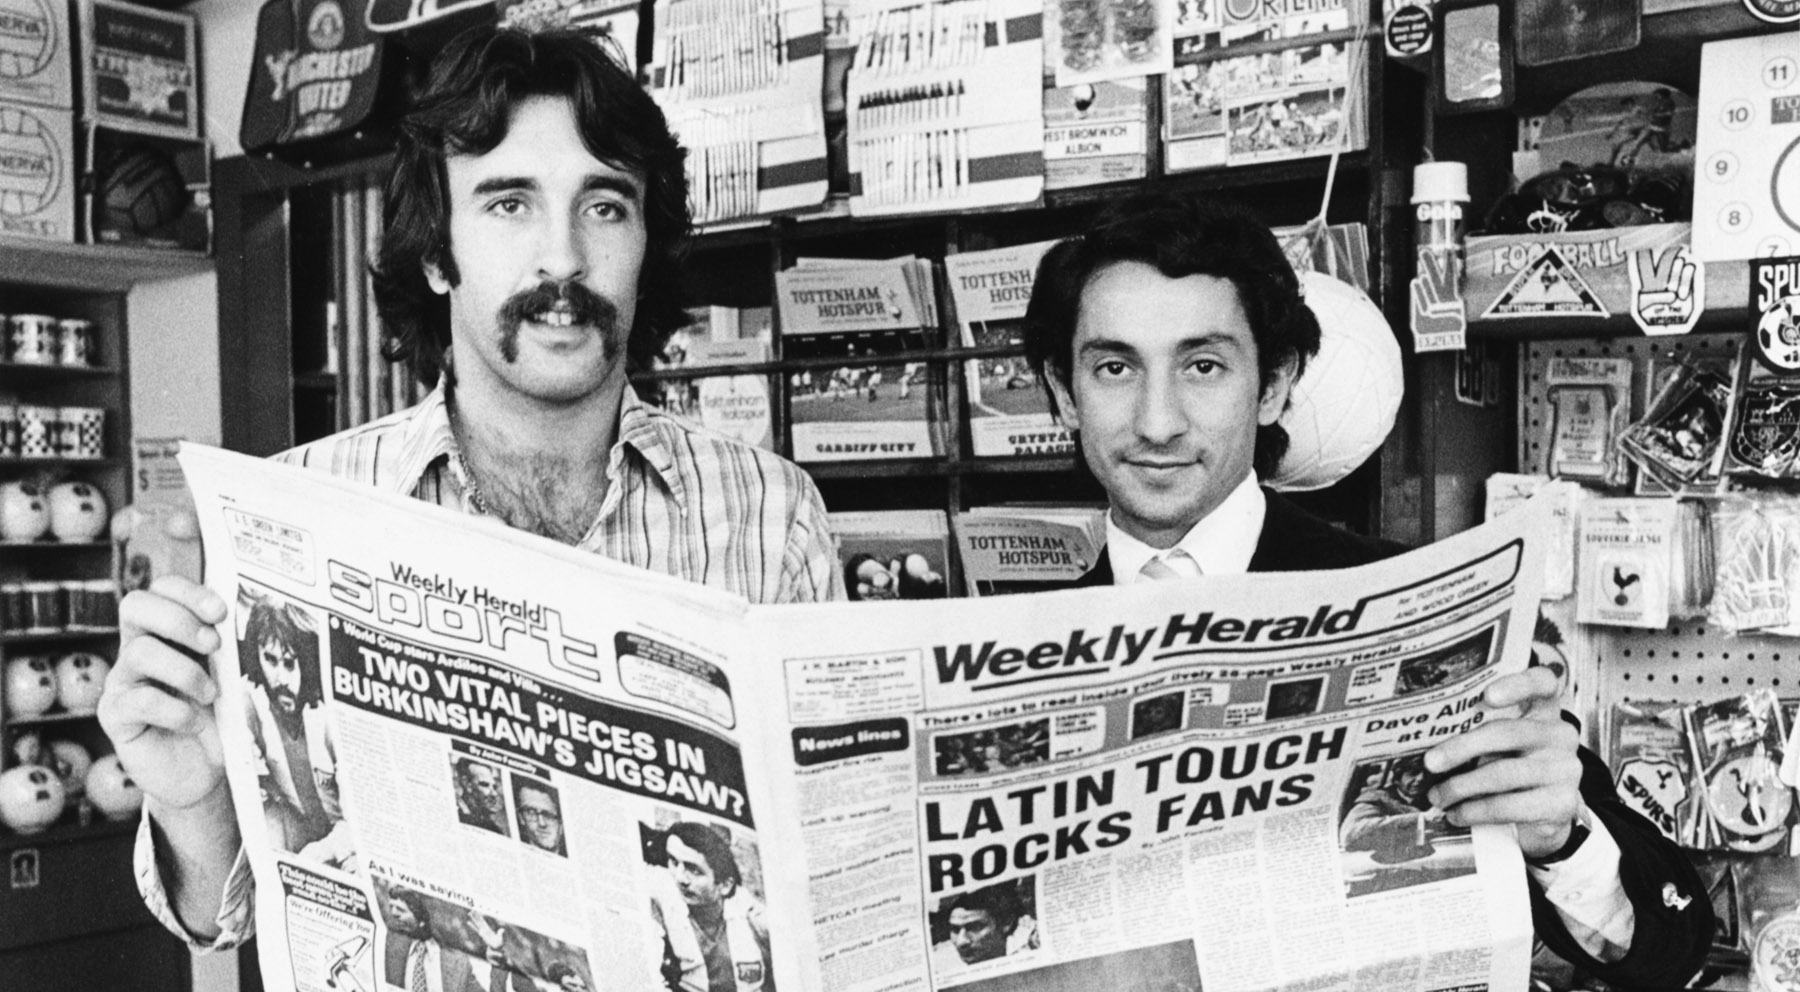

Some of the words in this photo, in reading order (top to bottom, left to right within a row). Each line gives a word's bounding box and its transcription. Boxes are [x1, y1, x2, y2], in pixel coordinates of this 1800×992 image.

[1769, 65, 1787, 81] 11
[1727, 106, 1749, 123] 10
[1068, 125, 1127, 139] BROMWICH
[1065, 143, 1101, 154] ALBION
[1715, 160, 1728, 175] 9
[1729, 211, 1741, 225] 8
[1492, 236, 1627, 278] FOBALL
[1767, 244, 1779, 258] 7
[789, 286, 882, 304] TOTTENHAM
[817, 302, 887, 318] HOTSPUR
[816, 443, 878, 453] CARDIFF
[880, 442, 916, 453] CITY
[968, 536, 1066, 551] TOTTENHAM
[998, 550, 1073, 566] HOTSPUR
[390, 560, 468, 605] Weekly
[473, 585, 541, 624] Herald
[327, 558, 602, 683] sport
[342, 619, 377, 645] World
[377, 631, 402, 655] Cup
[404, 645, 436, 663] stars
[437, 653, 487, 676] Ardiles
[488, 665, 511, 685] and
[933, 624, 1158, 684] Weekly
[1159, 597, 1368, 649] Herald
[923, 711, 983, 727] There's
[1041, 695, 1078, 707] read
[1290, 656, 1347, 672] Weekly
[1351, 644, 1402, 663] Herald
[358, 645, 431, 693] TWO
[434, 669, 532, 723] VITAL
[536, 701, 658, 762] PIECES
[664, 737, 707, 776] IN
[1365, 712, 1430, 734] Dave
[1396, 728, 1423, 743] at
[1428, 711, 1485, 735] large
[333, 664, 577, 768] BURKINSHAW'S
[583, 748, 745, 818] JIGSAW?
[799, 735, 855, 752] News
[857, 729, 902, 743] lines
[926, 769, 1116, 843] LATIN
[1135, 726, 1348, 795] TOUCH
[1622, 774, 1677, 834] SPURS
[928, 810, 1133, 894] ROCKS
[1156, 773, 1316, 834] FANS
[369, 859, 386, 875] As
[399, 872, 427, 888] was
[429, 883, 475, 908] saying
